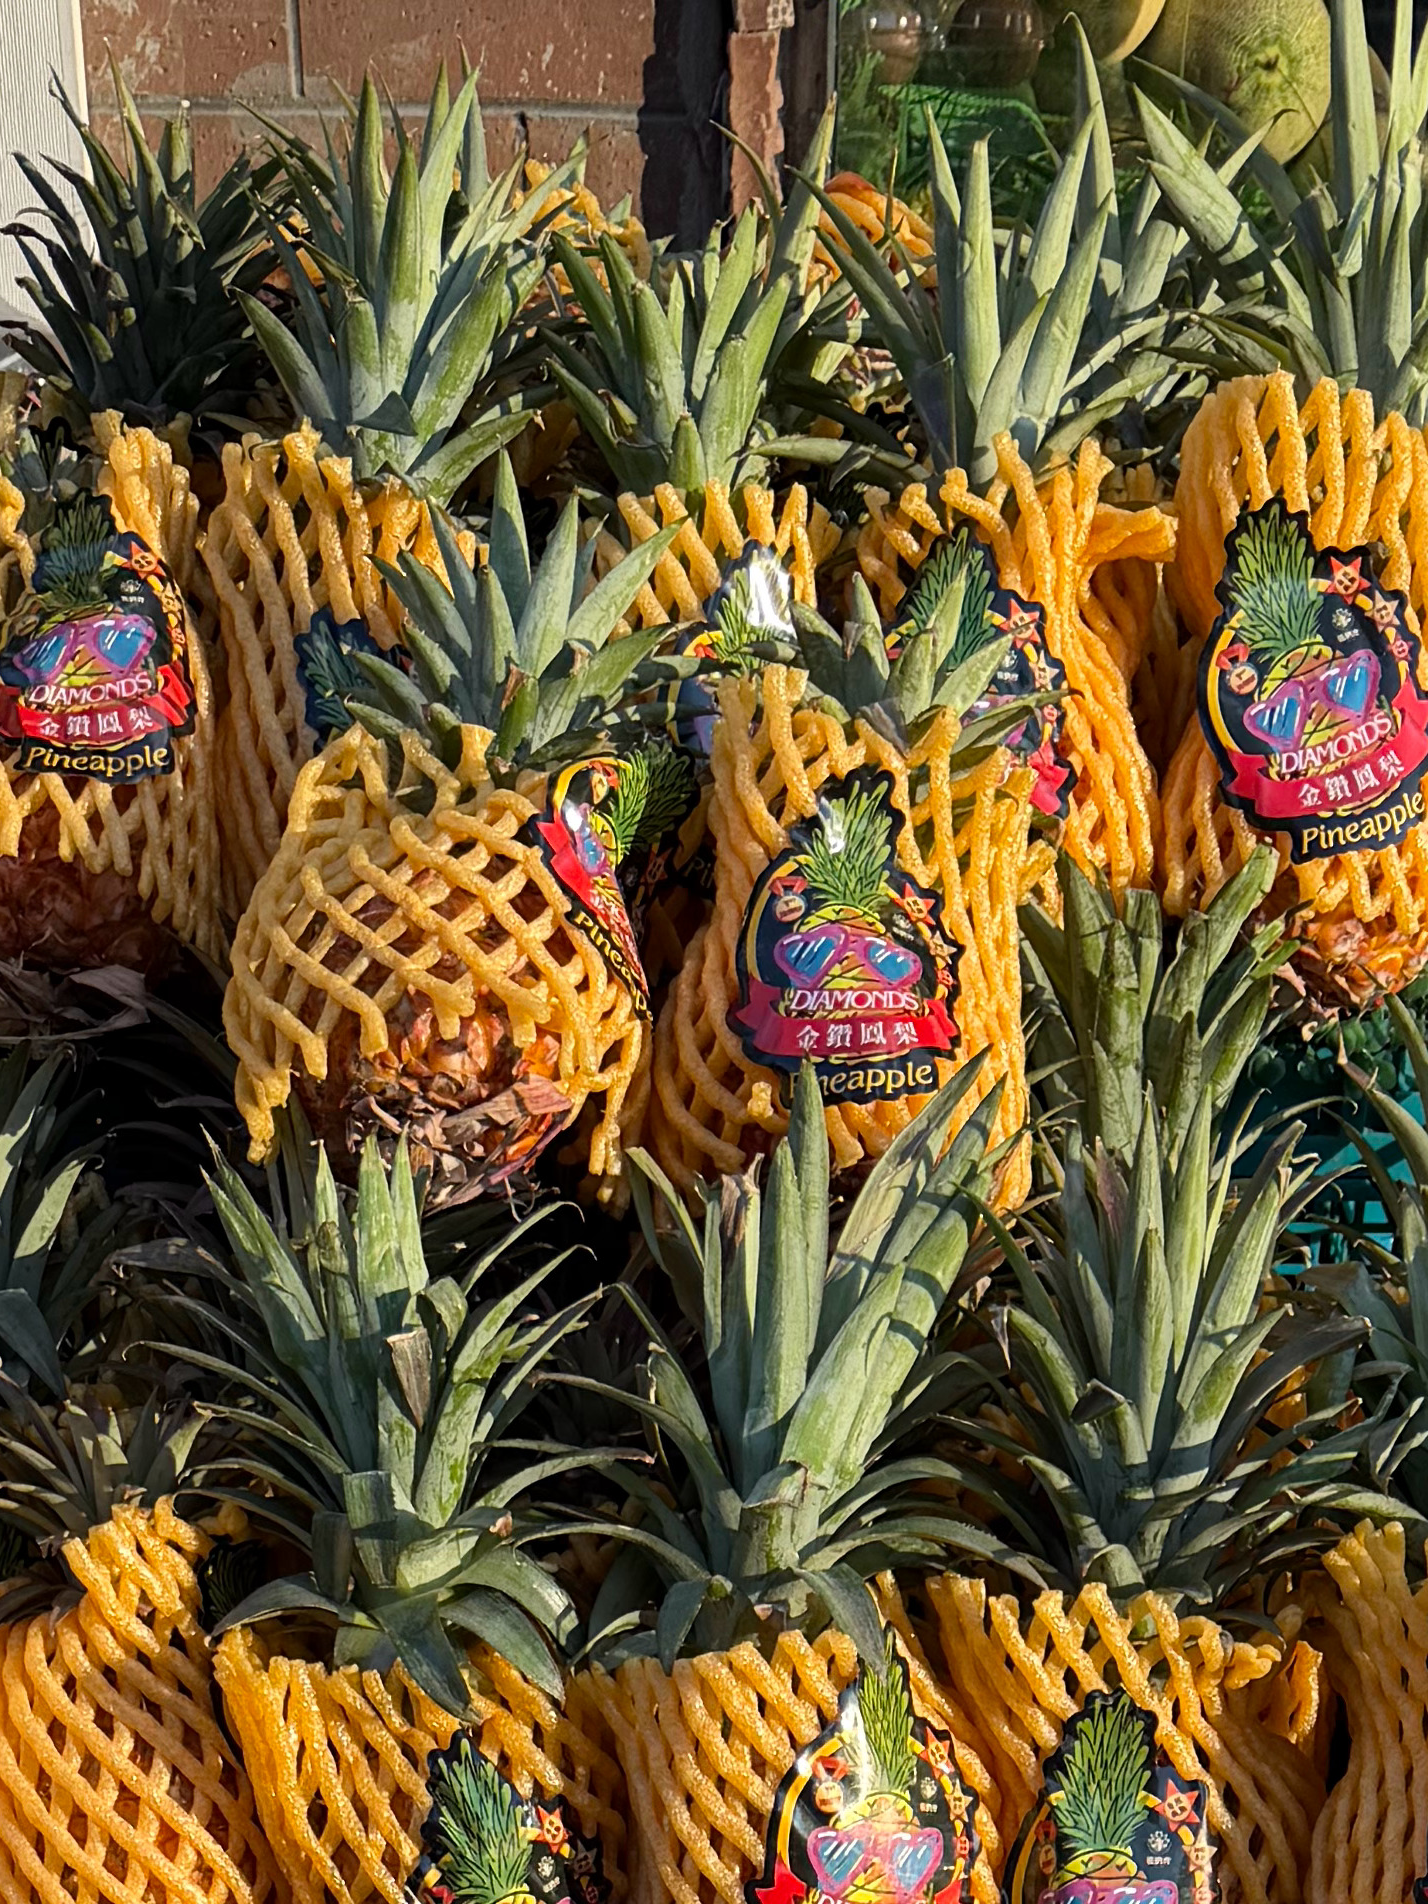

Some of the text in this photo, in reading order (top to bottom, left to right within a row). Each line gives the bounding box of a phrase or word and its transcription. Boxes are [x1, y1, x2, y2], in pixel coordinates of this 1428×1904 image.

[28, 671, 153, 704] DIAMONDS
[1279, 710, 1393, 774] DIAMONDS
[22, 745, 169, 777] Pineapple
[1301, 791, 1426, 854] Pineapple
[789, 989, 920, 1011] DIAMONDS
[790, 1061, 934, 1099] neapple
